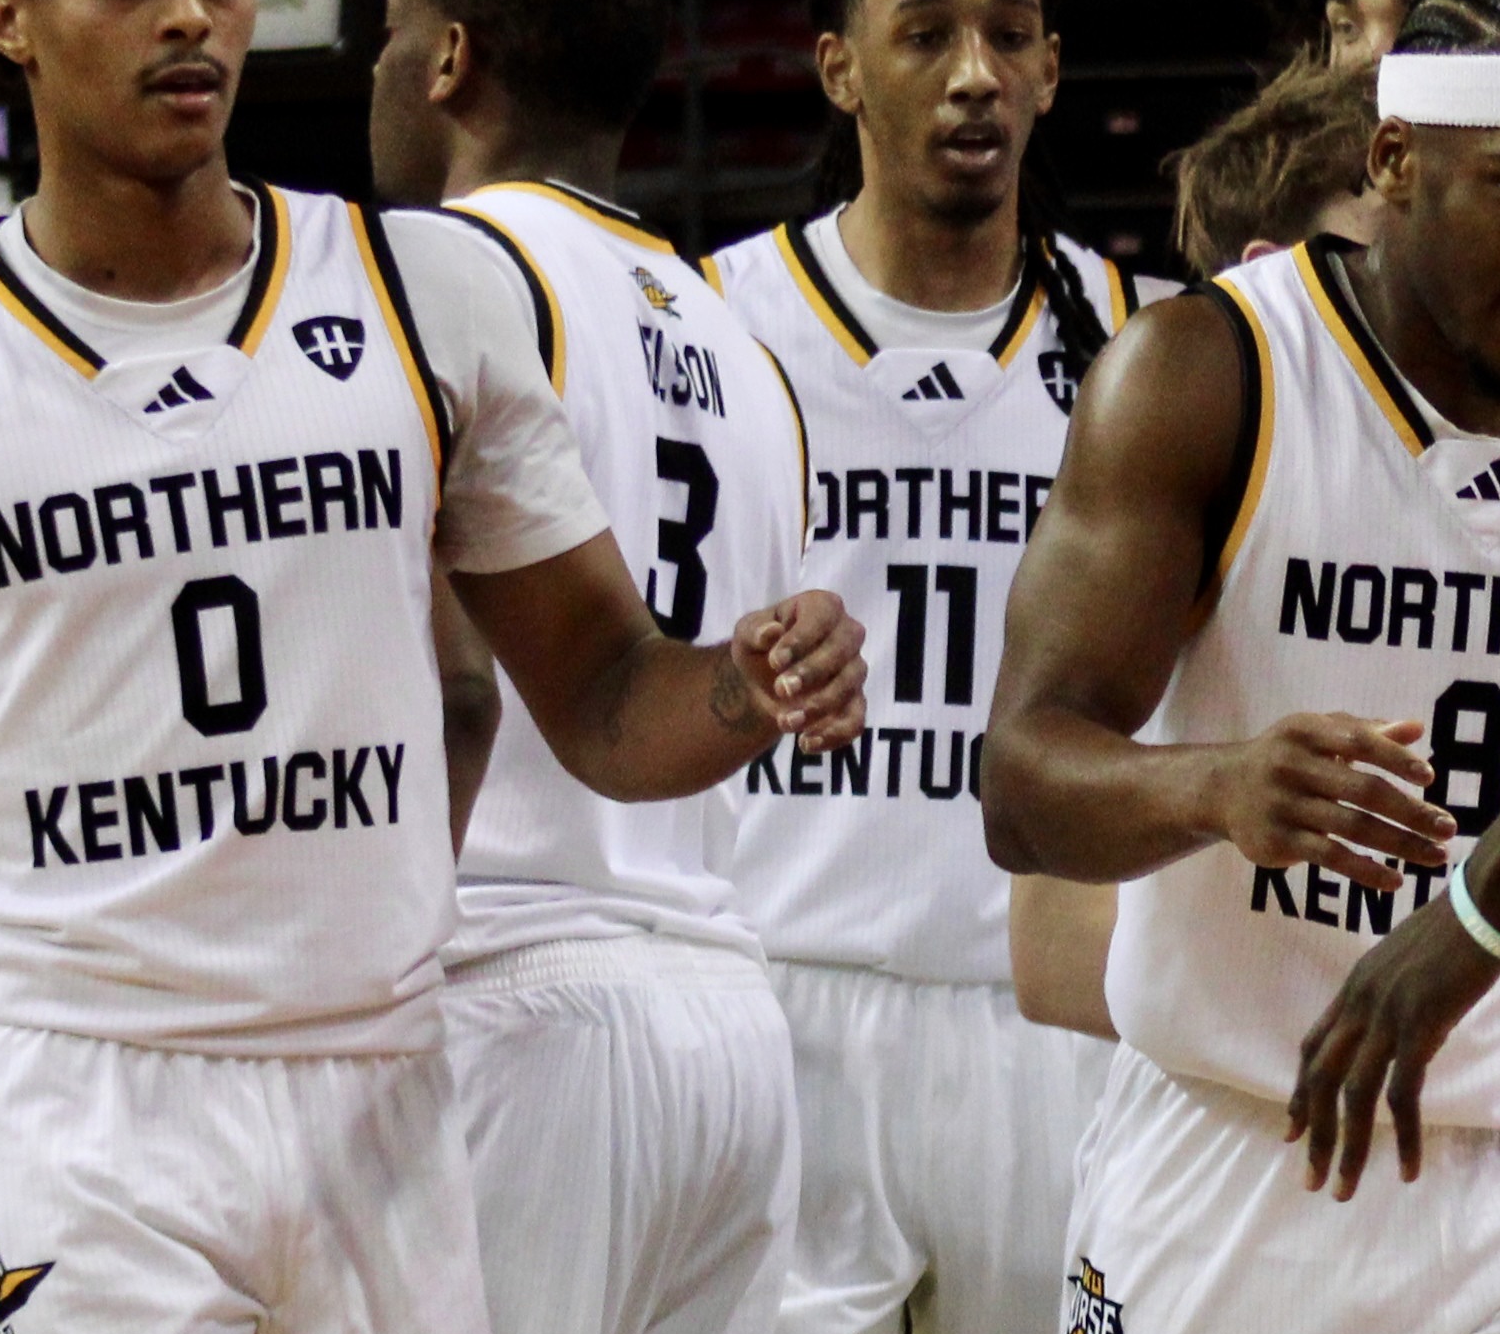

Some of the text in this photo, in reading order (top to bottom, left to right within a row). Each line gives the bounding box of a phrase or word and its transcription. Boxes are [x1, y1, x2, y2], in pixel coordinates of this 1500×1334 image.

[646, 435, 720, 645] 3
[171, 574, 267, 737] 0
[886, 564, 978, 707] 11
[25, 743, 405, 868] KENTUCKY
